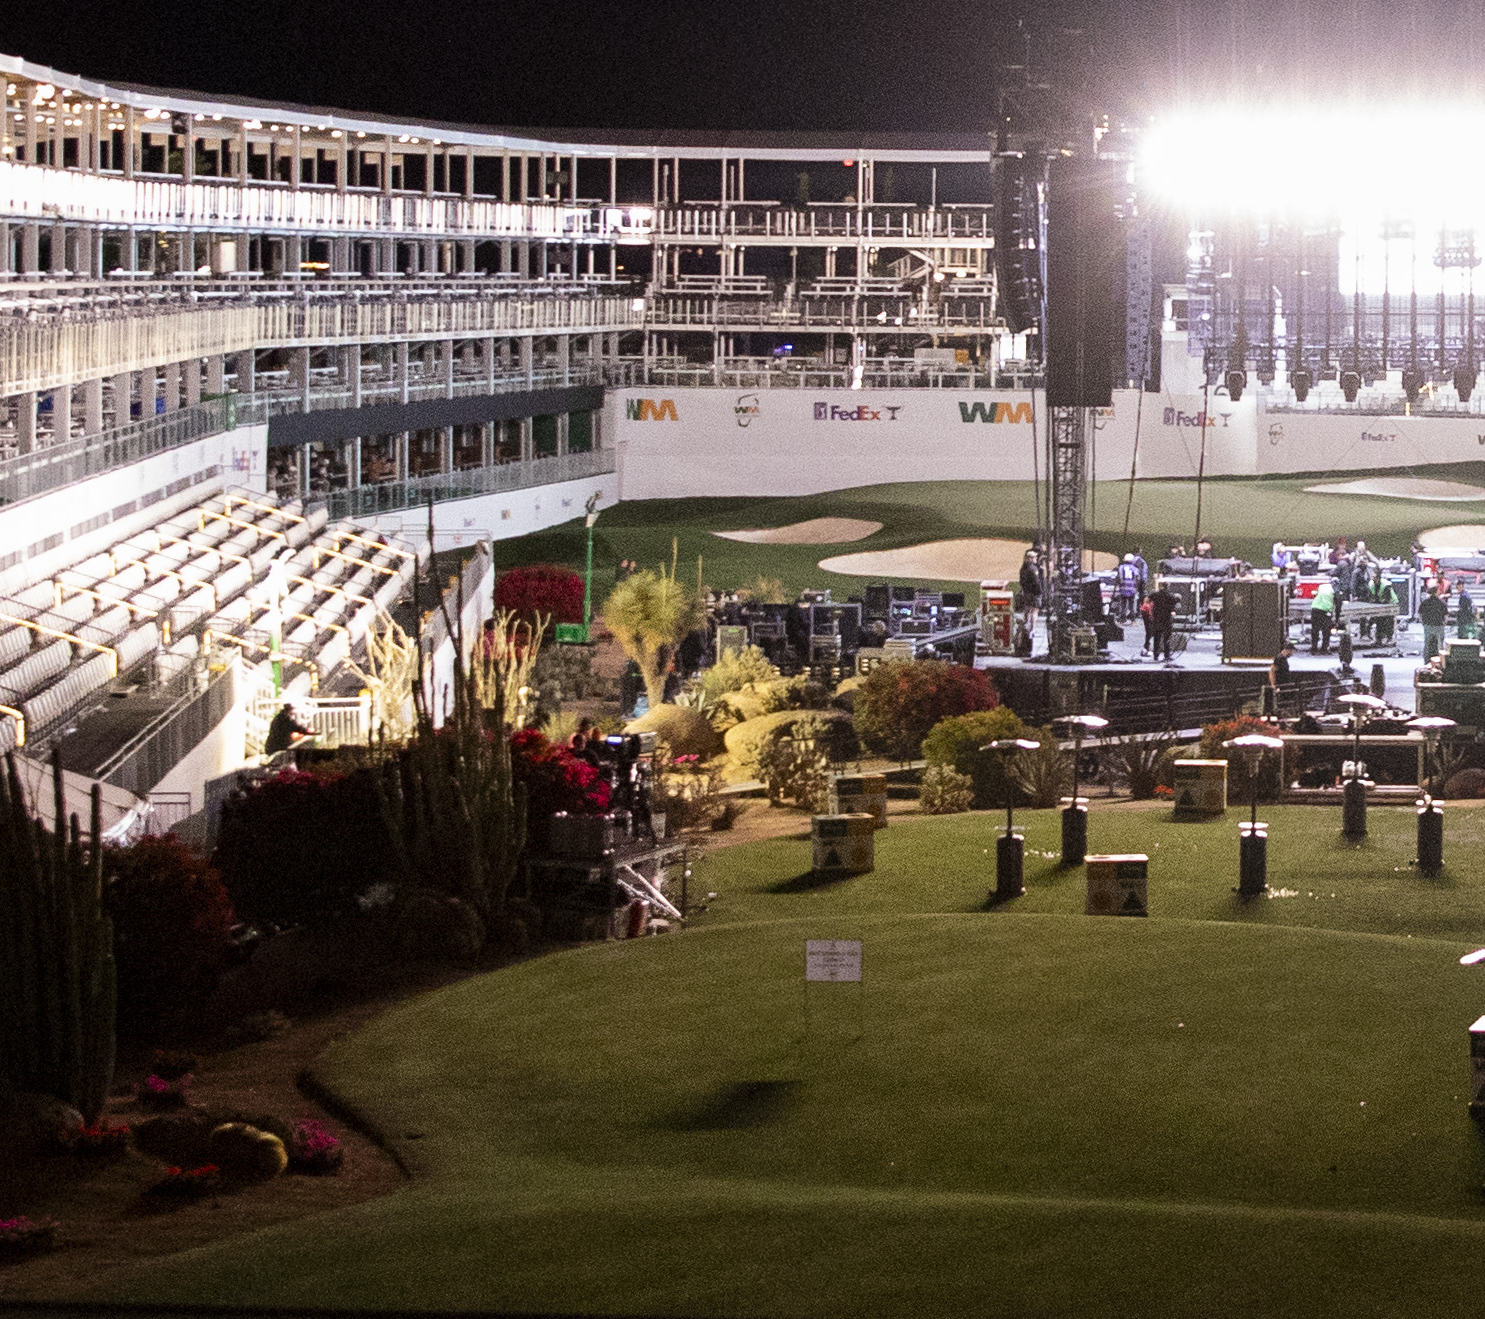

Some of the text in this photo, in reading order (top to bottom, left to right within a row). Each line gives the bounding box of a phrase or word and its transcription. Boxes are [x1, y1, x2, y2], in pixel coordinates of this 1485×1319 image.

[626, 399, 679, 421] WM
[830, 405, 881, 421] FedEx
[958, 402, 1033, 423] WM
[1176, 411, 1216, 427] FedEx
